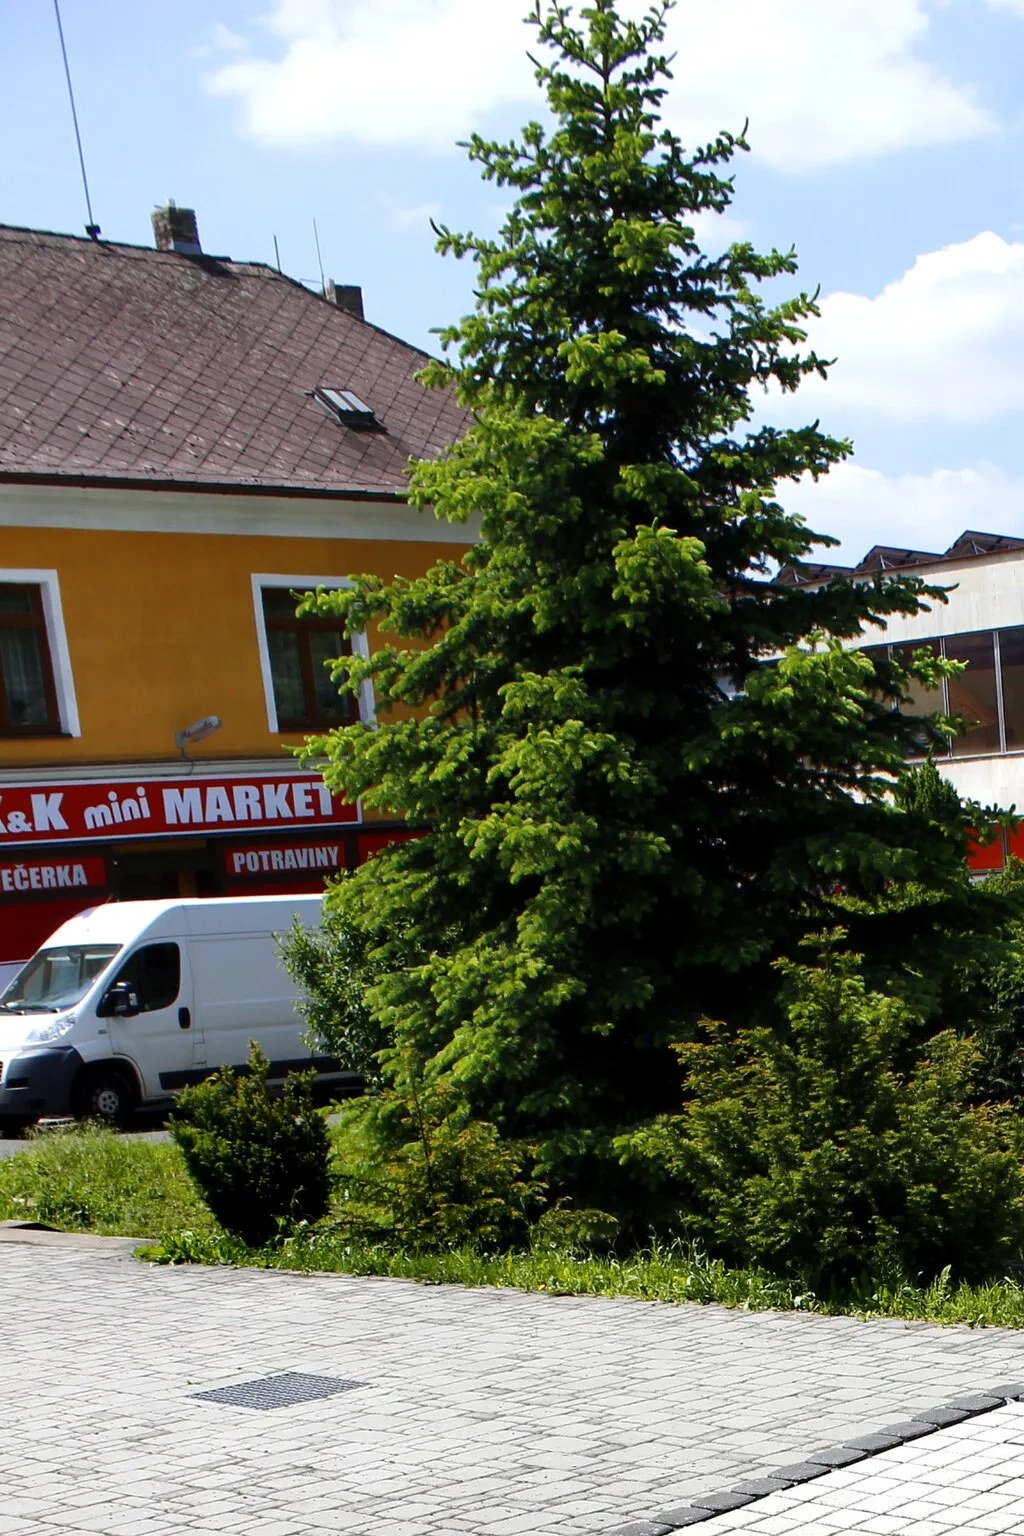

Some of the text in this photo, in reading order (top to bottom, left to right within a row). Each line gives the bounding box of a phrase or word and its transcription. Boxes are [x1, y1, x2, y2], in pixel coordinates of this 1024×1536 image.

[84, 786, 151, 830] mini
[162, 781, 333, 825] MARKET
[232, 846, 339, 873] POTRAVINY
